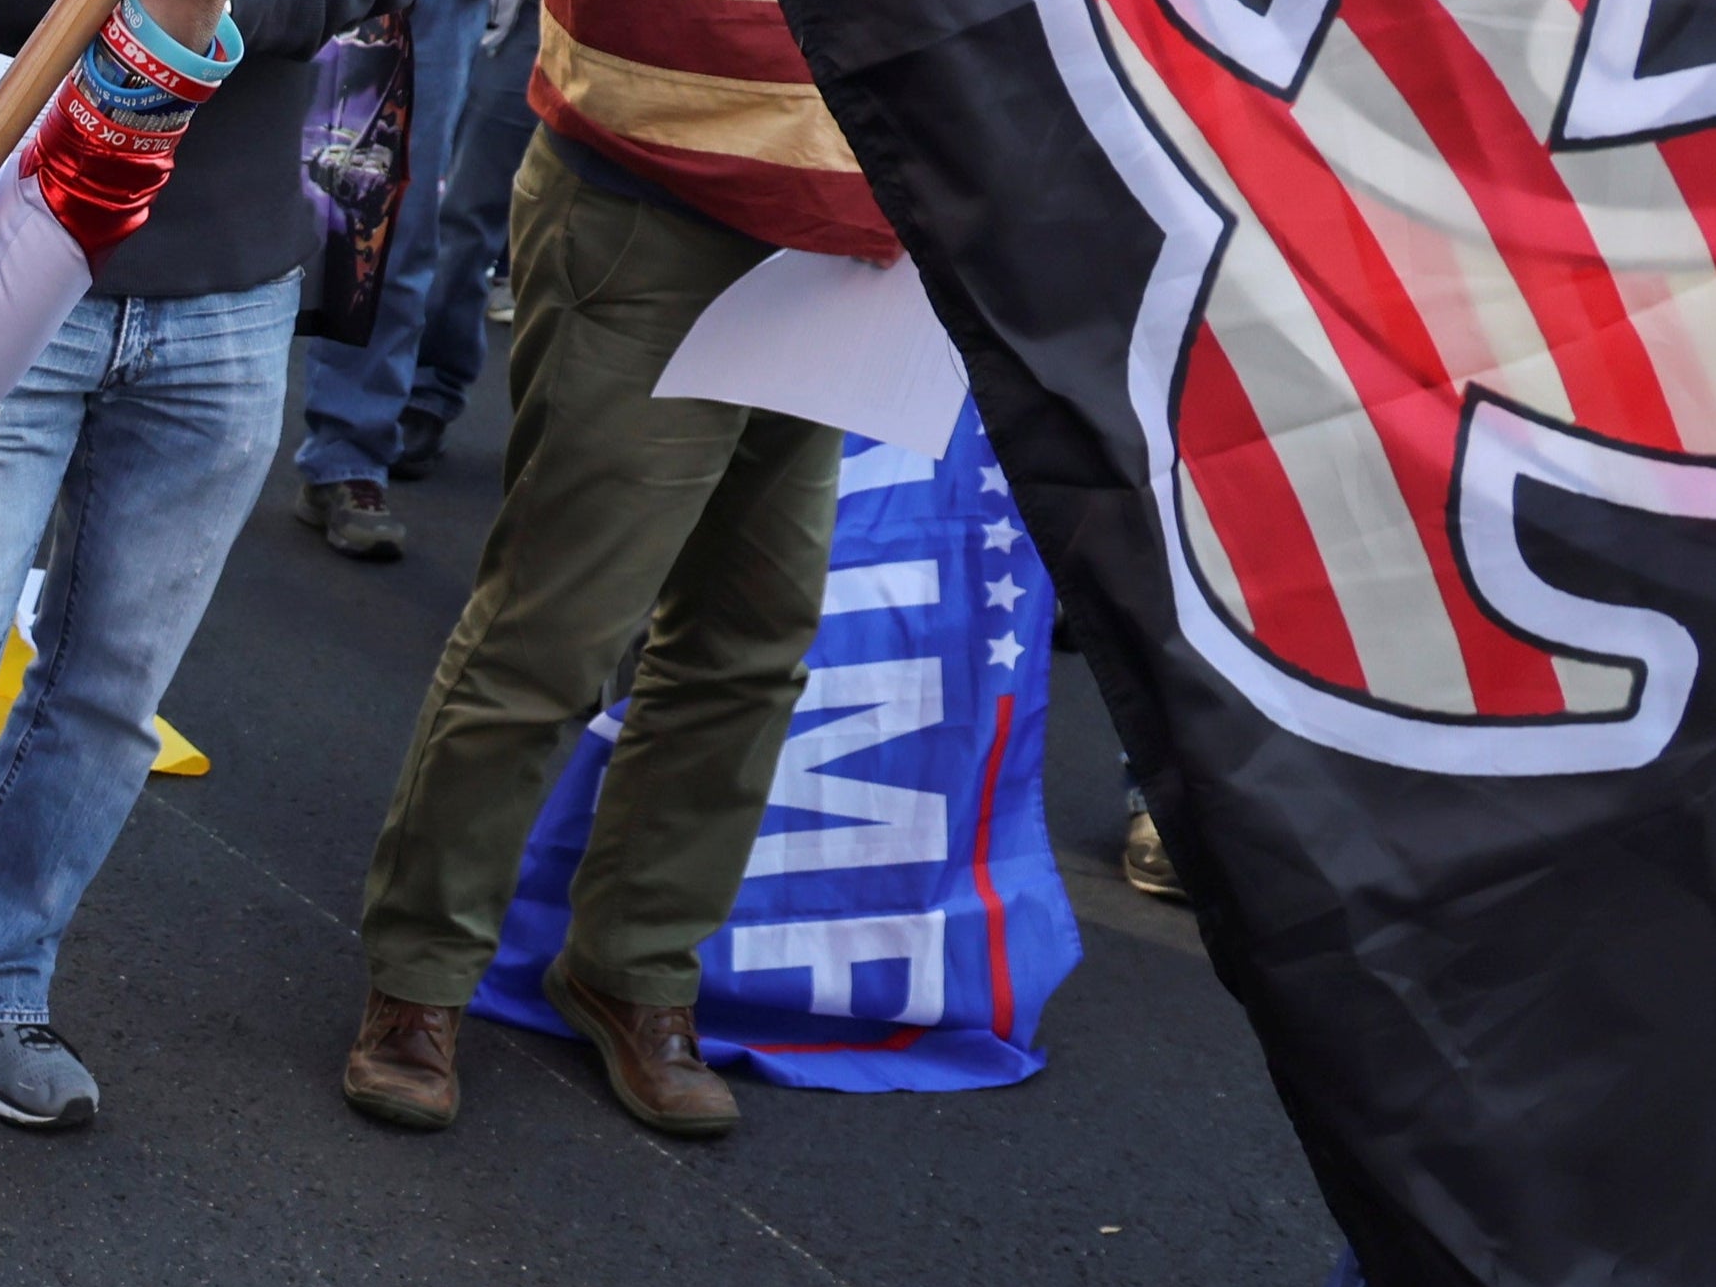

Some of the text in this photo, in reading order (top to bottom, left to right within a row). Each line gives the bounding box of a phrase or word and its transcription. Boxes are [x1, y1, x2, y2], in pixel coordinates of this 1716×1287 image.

[113, 93, 137, 108] the
[68, 98, 99, 132] 2020
[99, 125, 127, 146] OK
[133, 135, 175, 151] TULSA,
